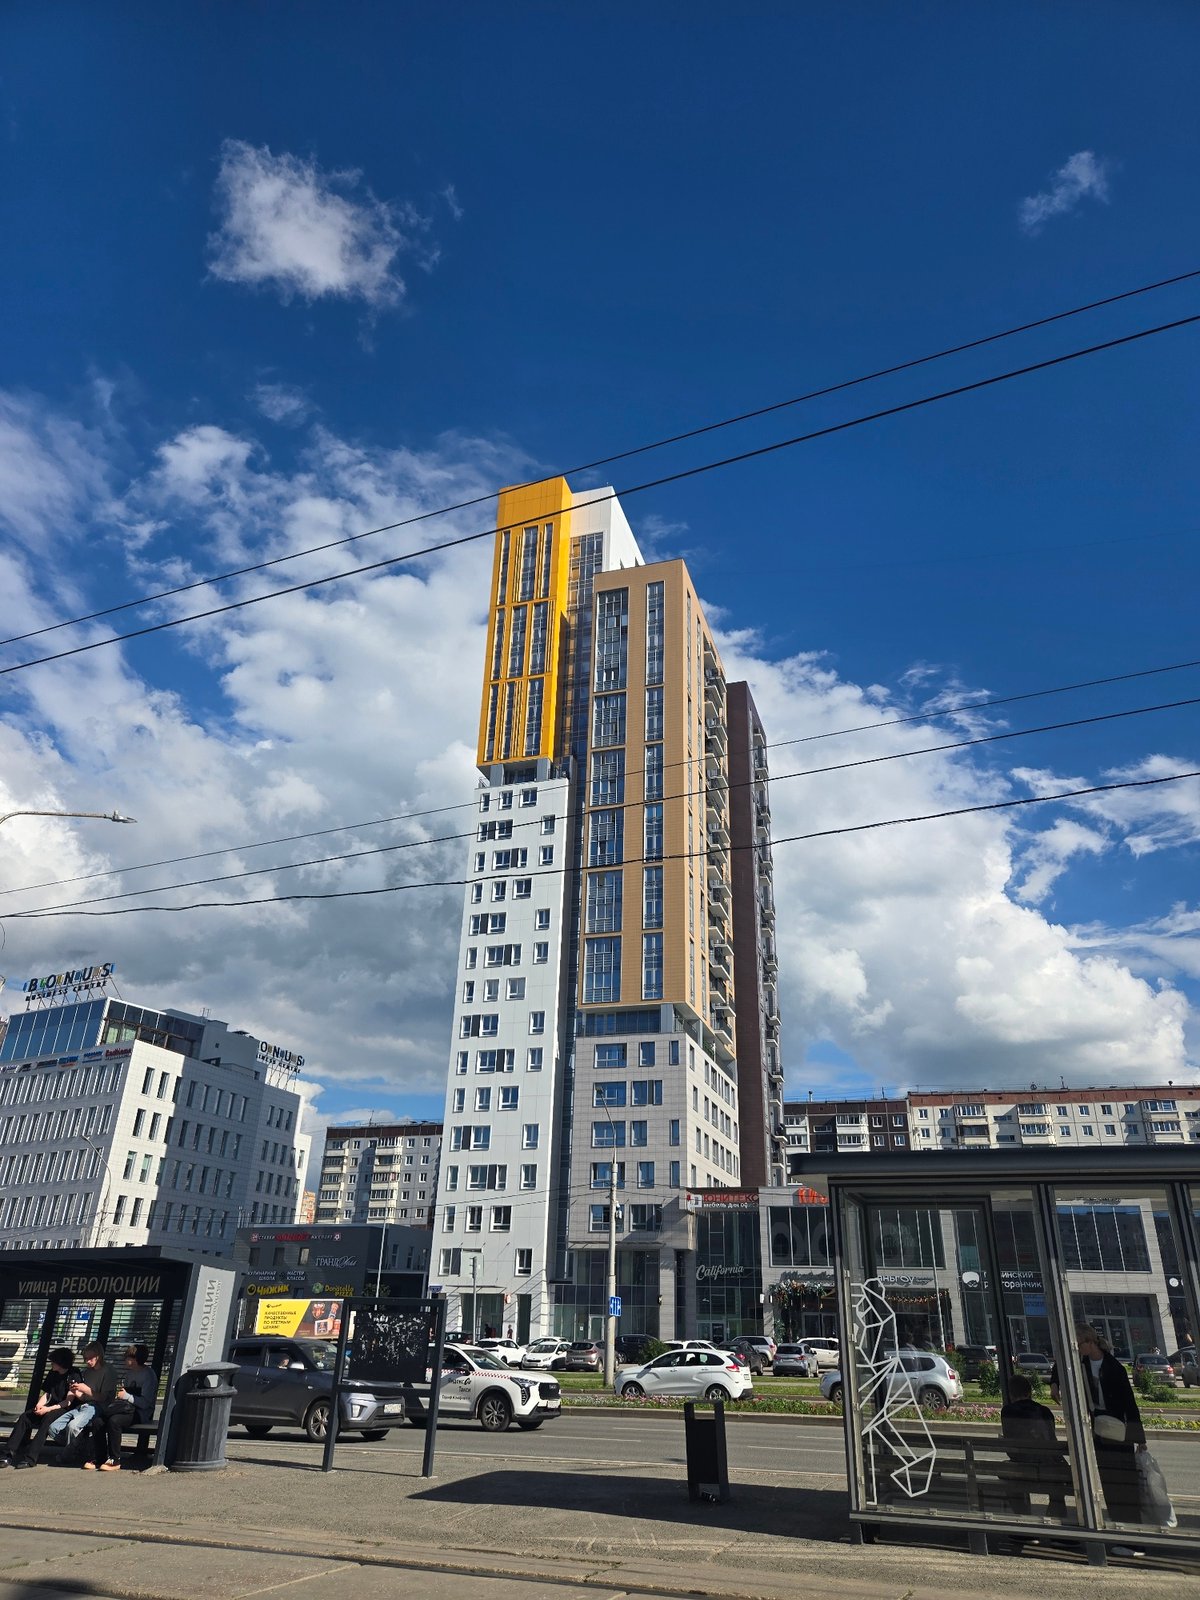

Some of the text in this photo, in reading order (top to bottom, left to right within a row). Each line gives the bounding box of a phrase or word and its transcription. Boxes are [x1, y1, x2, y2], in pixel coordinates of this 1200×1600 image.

[28, 963, 111, 992] BONUS
[260, 1041, 304, 1066] ONUS
[696, 1264, 745, 1280] California
[18, 1276, 161, 1297] улица РЕВОЛЮЦИИ
